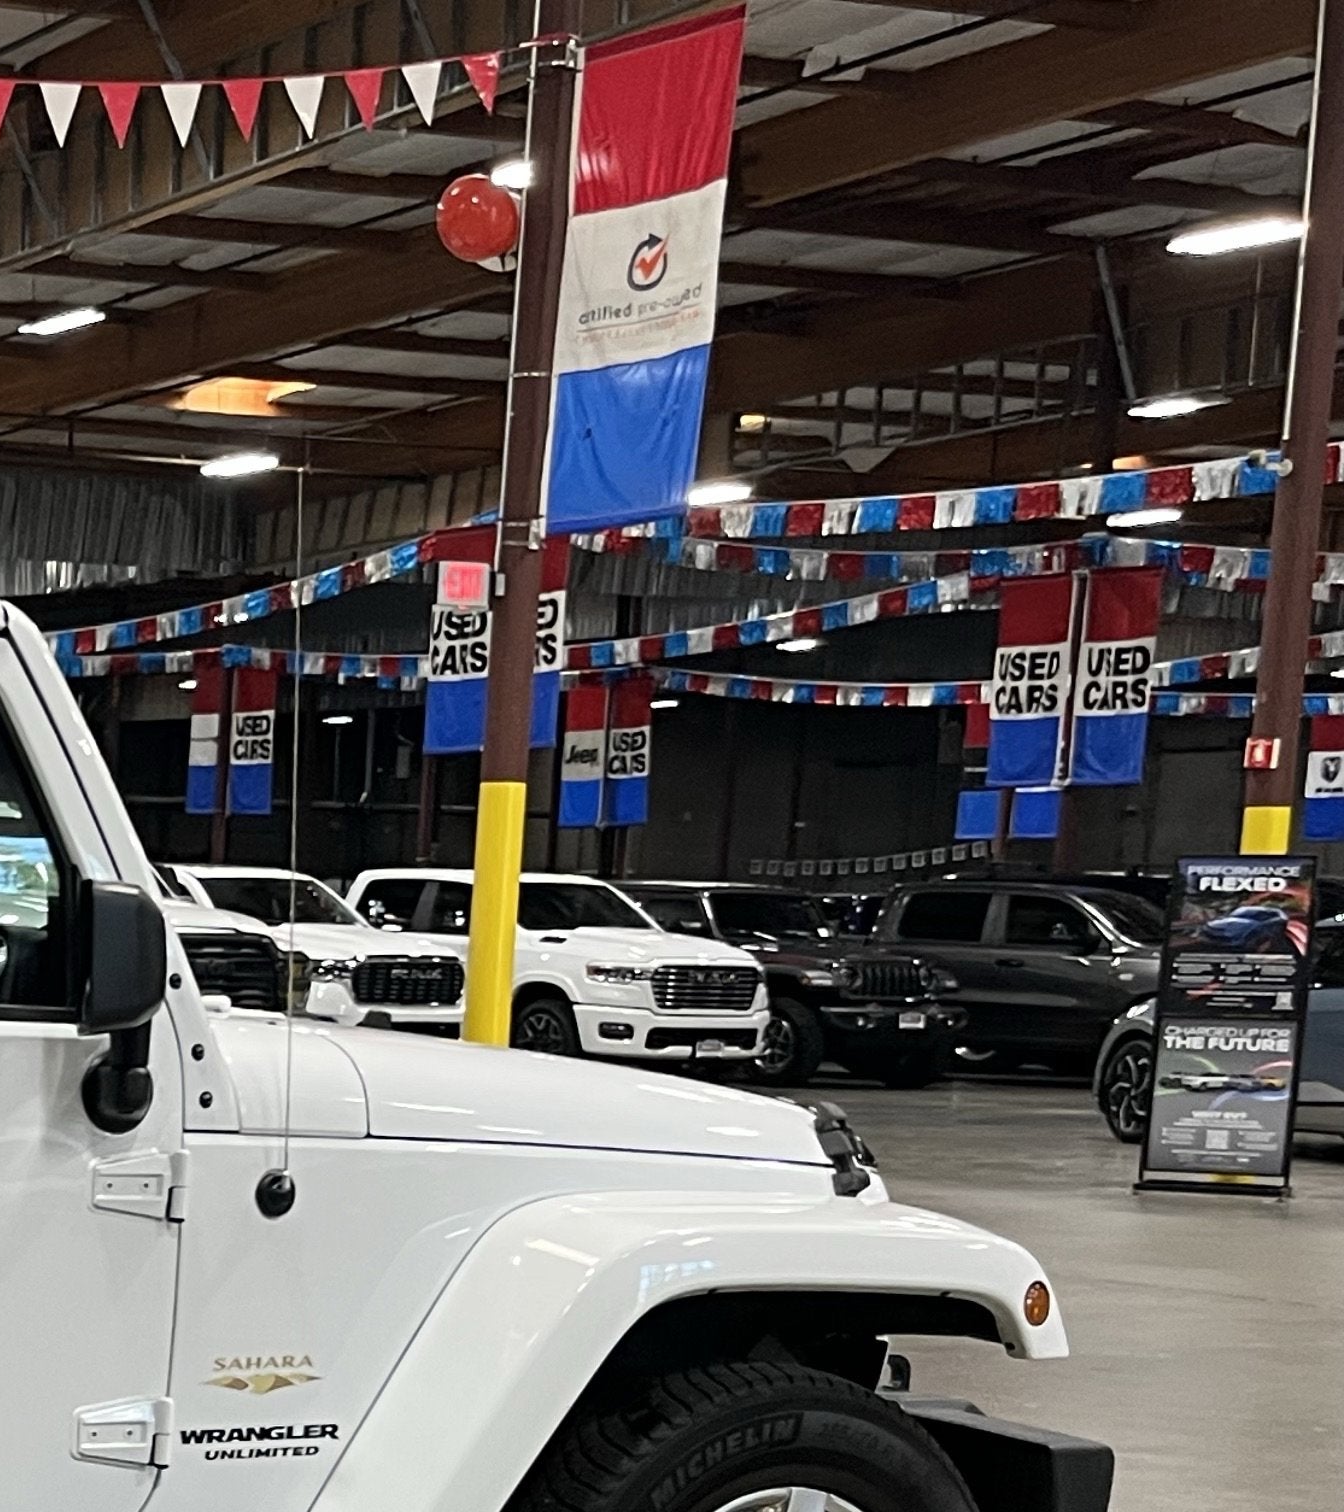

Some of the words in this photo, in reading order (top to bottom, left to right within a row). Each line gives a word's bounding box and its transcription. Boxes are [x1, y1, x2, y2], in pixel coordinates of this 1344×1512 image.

[432, 610, 488, 641] USED
[998, 651, 1061, 681] USED
[994, 684, 1059, 714] CARS
[1082, 678, 1149, 711] CARS
[235, 714, 271, 737] USED
[1187, 865, 1301, 877] PERFORMANCE
[1199, 877, 1287, 892] FLEXED
[1164, 1025, 1238, 1037] CHARGED
[1239, 1028, 1259, 1037] UP
[1260, 1028, 1291, 1039] FOR
[1163, 1036, 1205, 1049] THE
[1208, 1037, 1290, 1052] FUTURE
[212, 1354, 314, 1372] SAHARA
[179, 1422, 340, 1446] WRANGLER
[204, 1445, 320, 1461] UNLIMITED
[649, 1418, 799, 1511] MICHELIN
